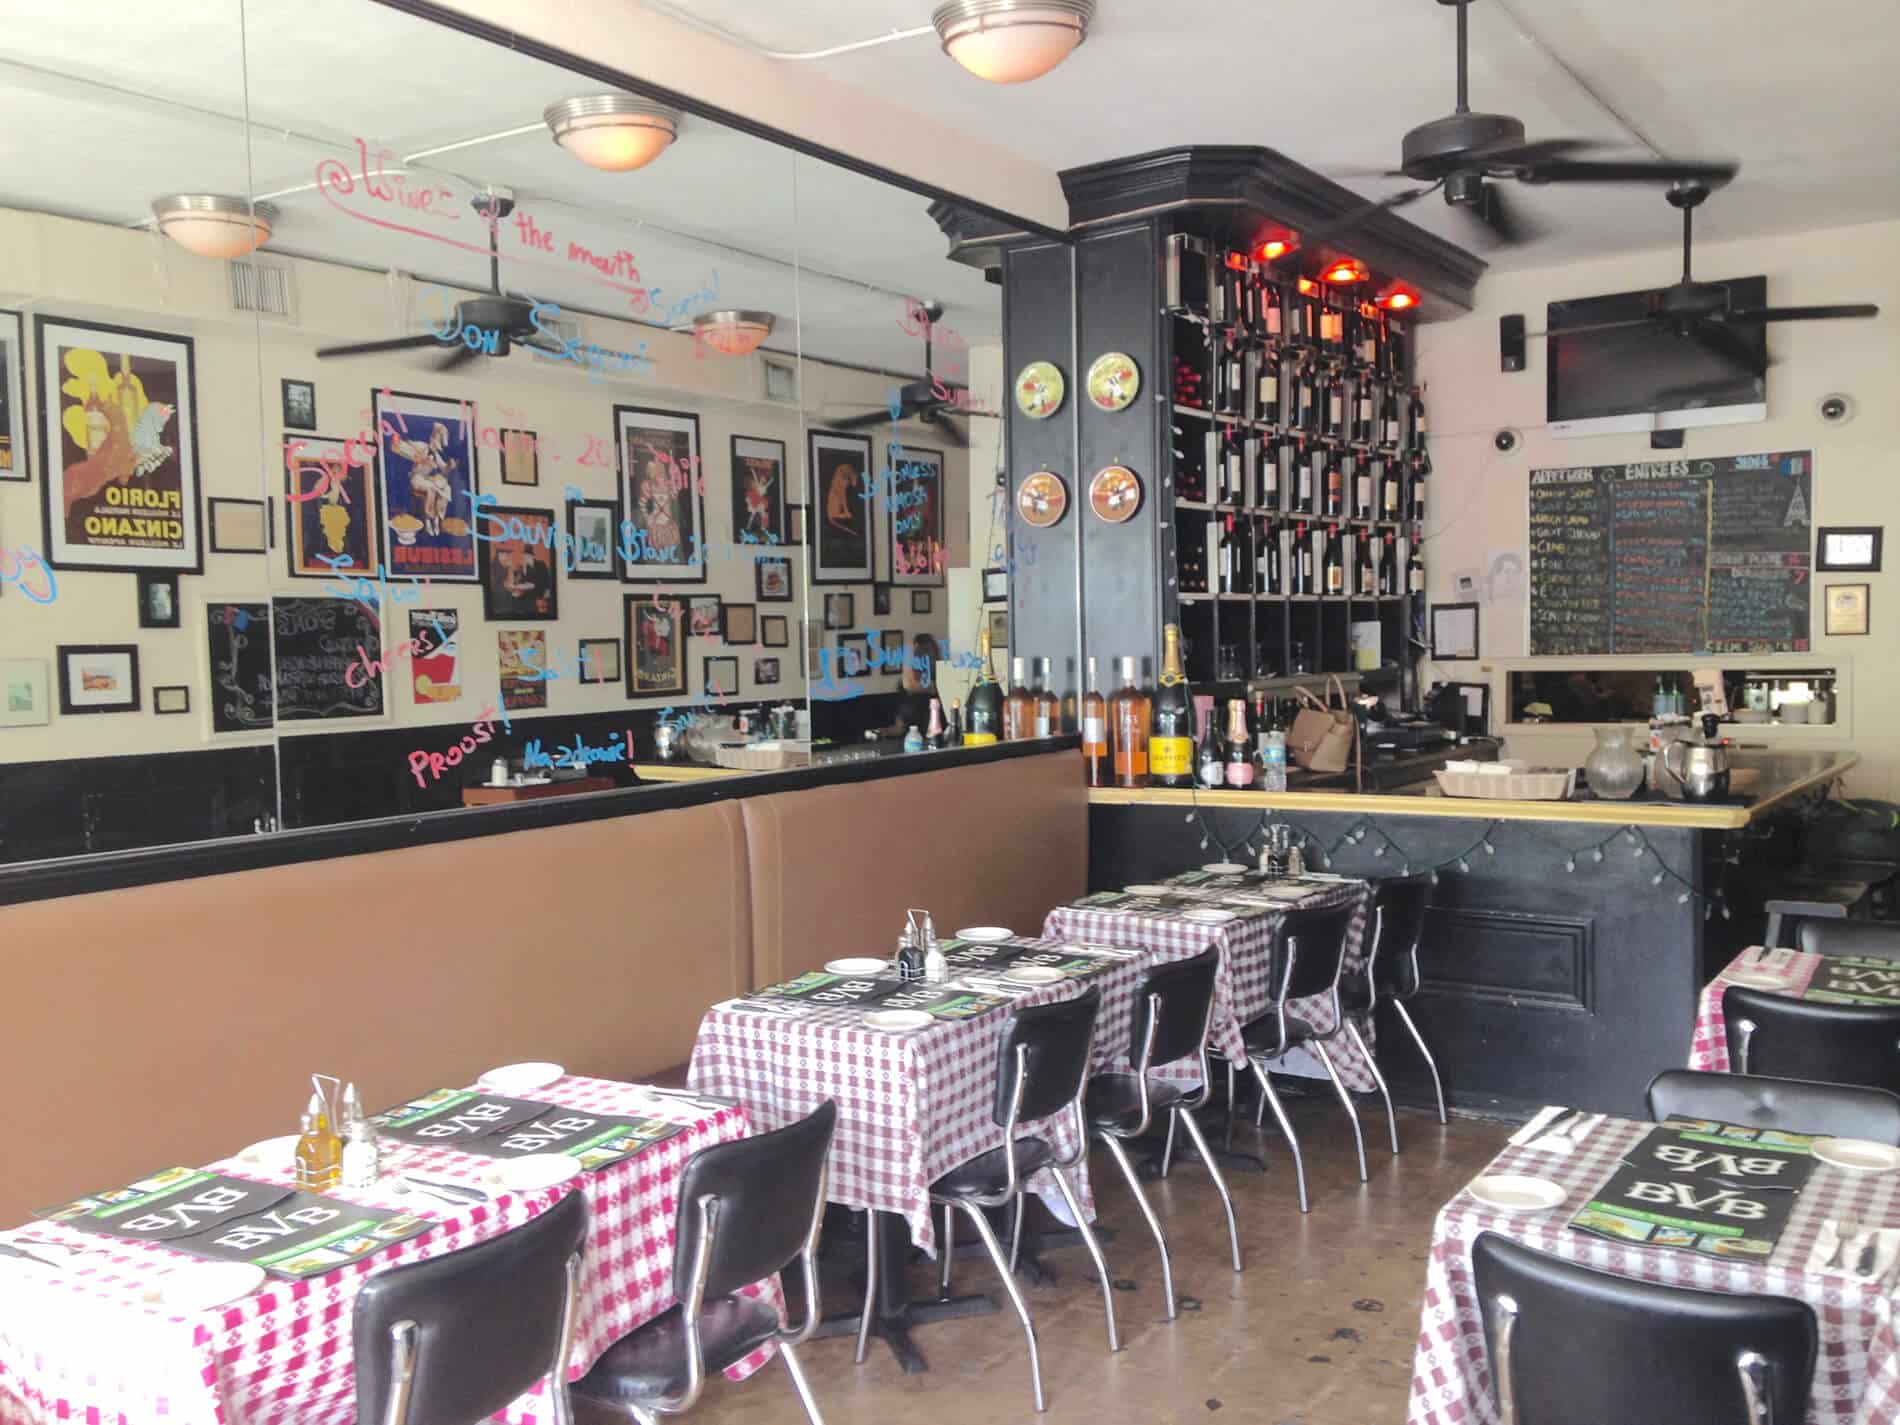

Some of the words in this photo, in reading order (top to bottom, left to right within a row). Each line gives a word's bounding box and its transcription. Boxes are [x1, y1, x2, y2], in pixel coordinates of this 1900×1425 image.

[514, 211, 555, 252] the
[810, 980, 877, 1002] BVB
[415, 1101, 512, 1138] BVB
[501, 1116, 598, 1152] BVB
[1651, 1143, 1790, 1177] BVB
[119, 1186, 249, 1232] BVB
[1623, 1180, 1769, 1220] BVB
[212, 1205, 342, 1251] BVB
